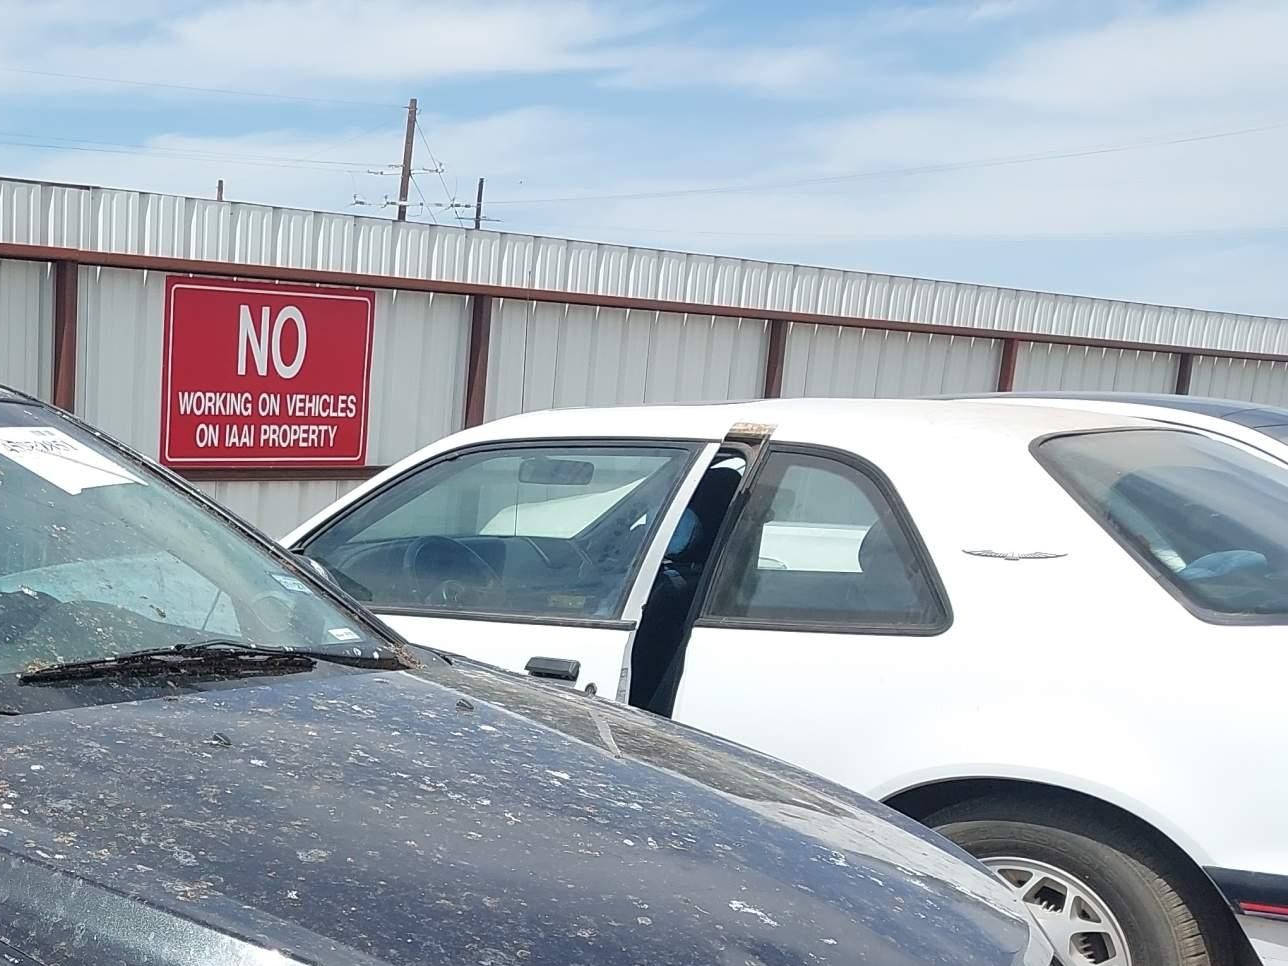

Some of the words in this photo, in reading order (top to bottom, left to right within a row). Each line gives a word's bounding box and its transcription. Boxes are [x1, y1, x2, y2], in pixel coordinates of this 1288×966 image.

[237, 304, 307, 379] NO
[178, 391, 252, 416] WORKING
[258, 392, 281, 416] ON
[286, 394, 357, 417] VEHICLES
[195, 423, 220, 447] ON
[225, 424, 255, 447] IAAI
[260, 424, 338, 447] PROPERTY
